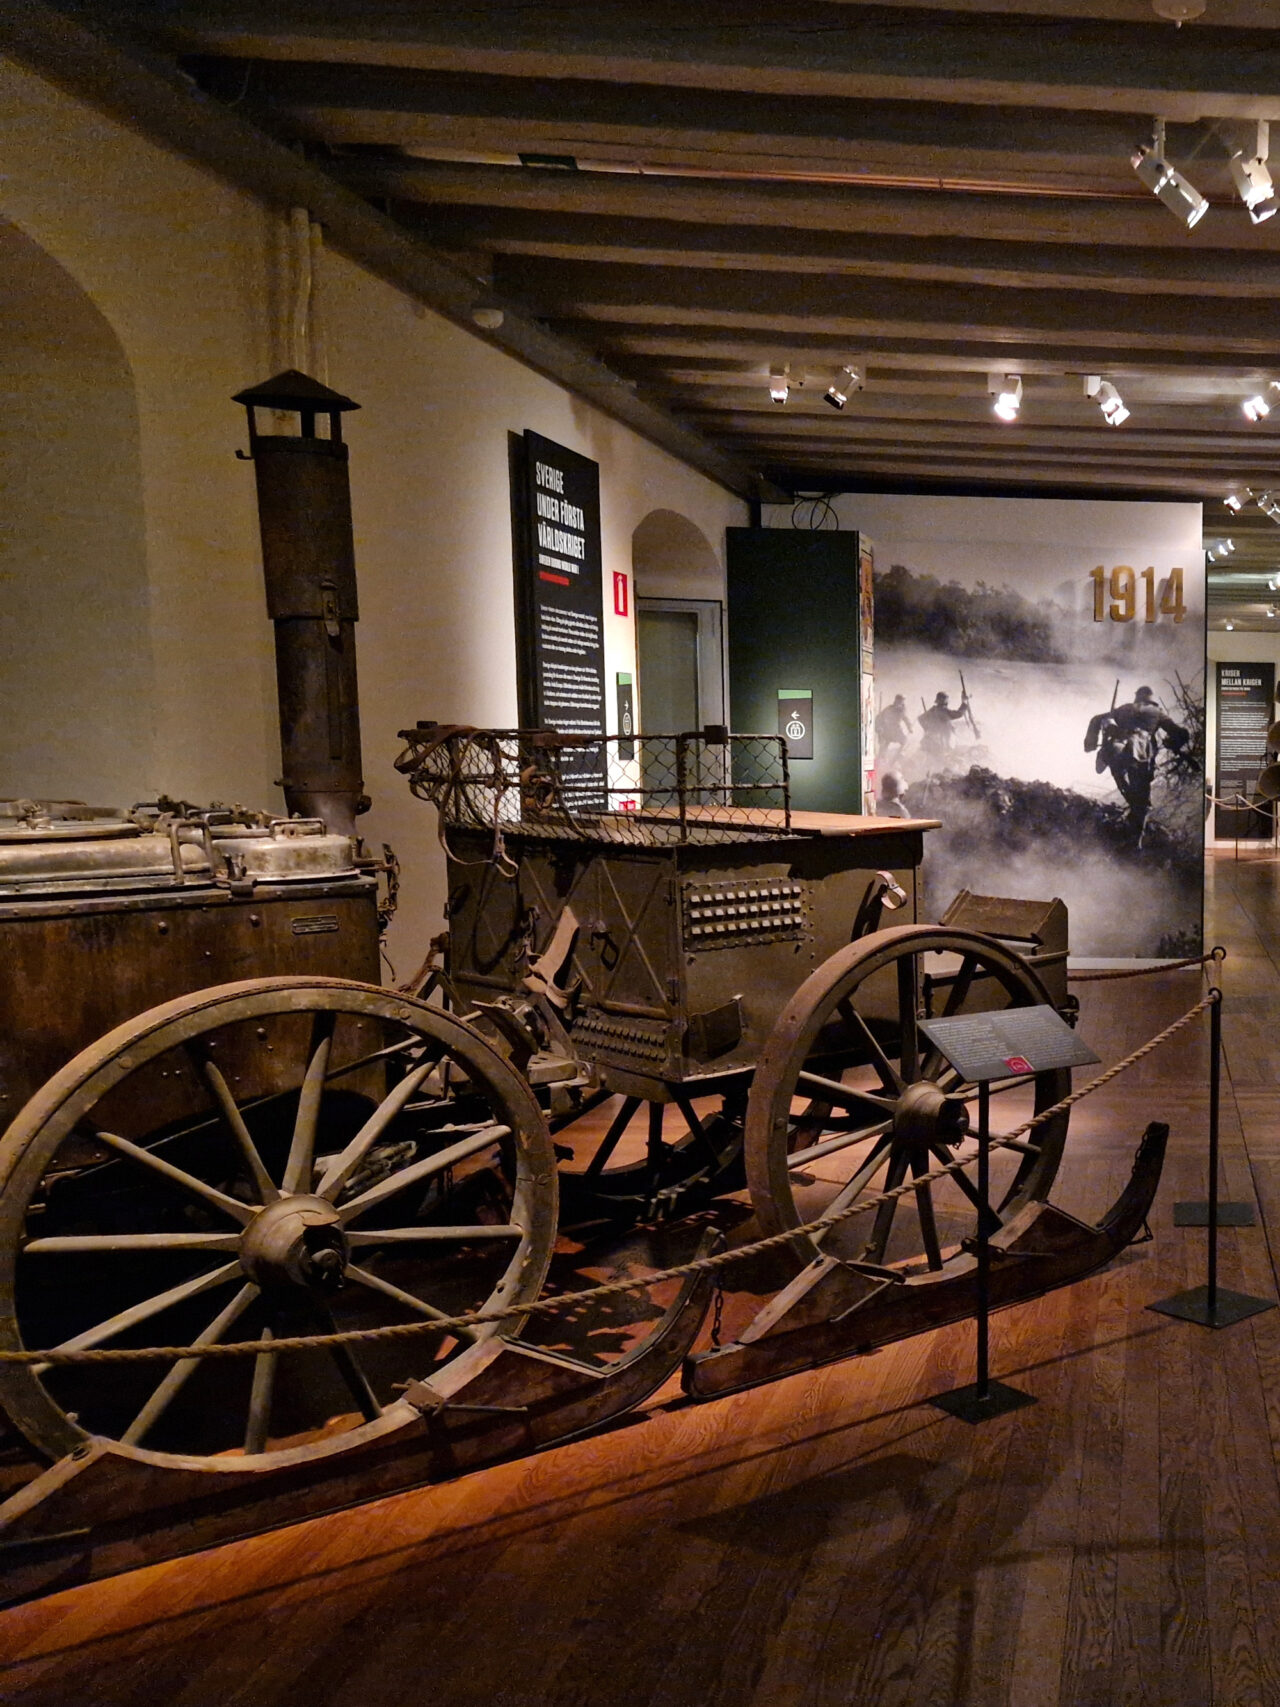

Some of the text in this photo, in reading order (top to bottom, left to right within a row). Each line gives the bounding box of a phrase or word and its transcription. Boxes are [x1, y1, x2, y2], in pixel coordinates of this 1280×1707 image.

[536, 461, 564, 494] SVERIGE
[536, 492, 585, 532] UNDER FÖRSTA
[537, 521, 586, 561] VÄRLDSKRIGET
[1090, 565, 1187, 623] 1914
[1221, 678, 1241, 686] MELLAN
